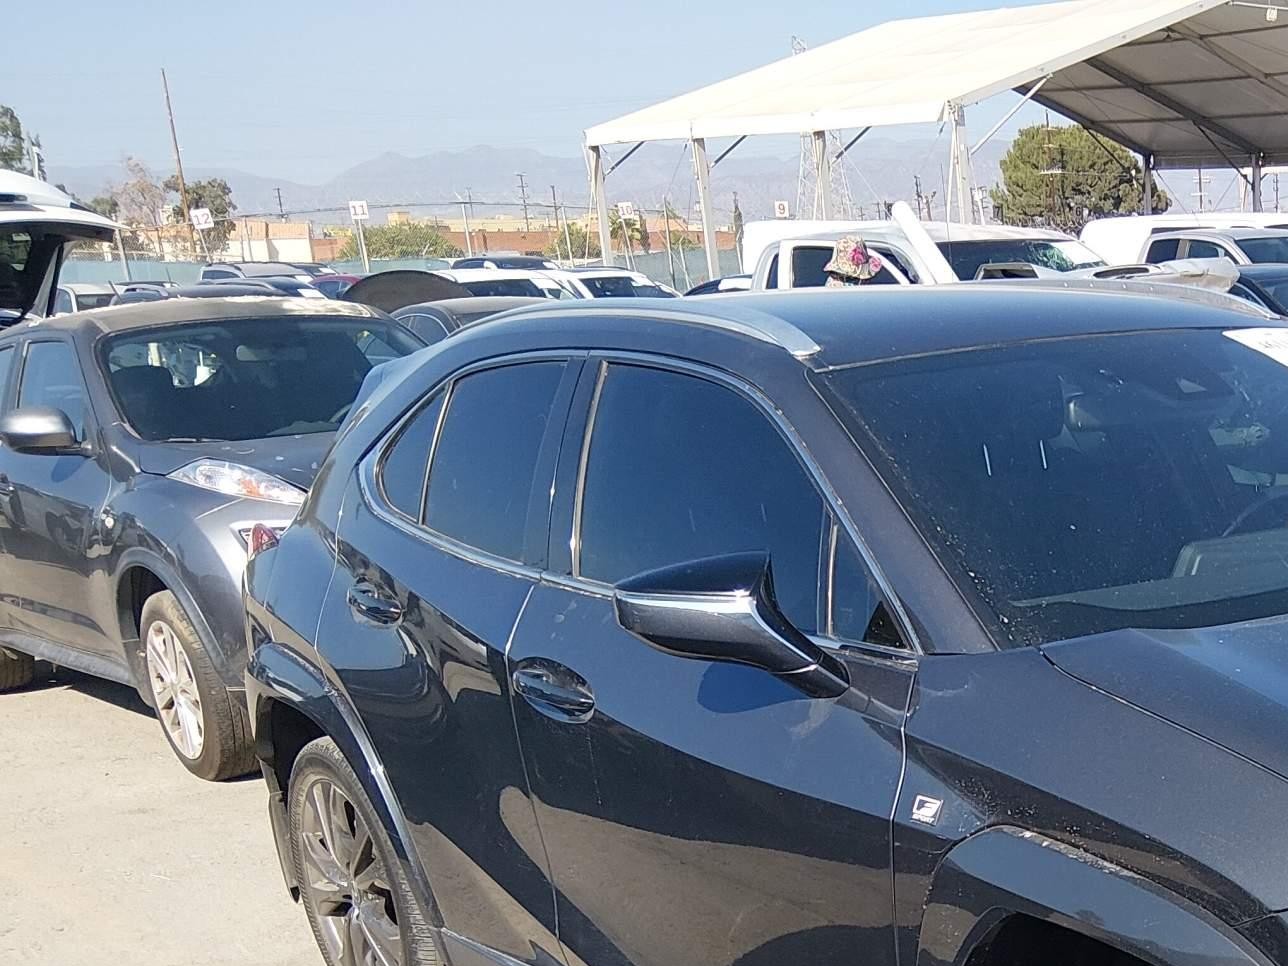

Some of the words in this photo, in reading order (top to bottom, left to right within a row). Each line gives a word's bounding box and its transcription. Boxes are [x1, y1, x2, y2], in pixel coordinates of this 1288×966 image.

[351, 203, 368, 216] 11
[619, 205, 632, 216] 10
[777, 203, 786, 215] 9
[193, 212, 211, 225] 12
